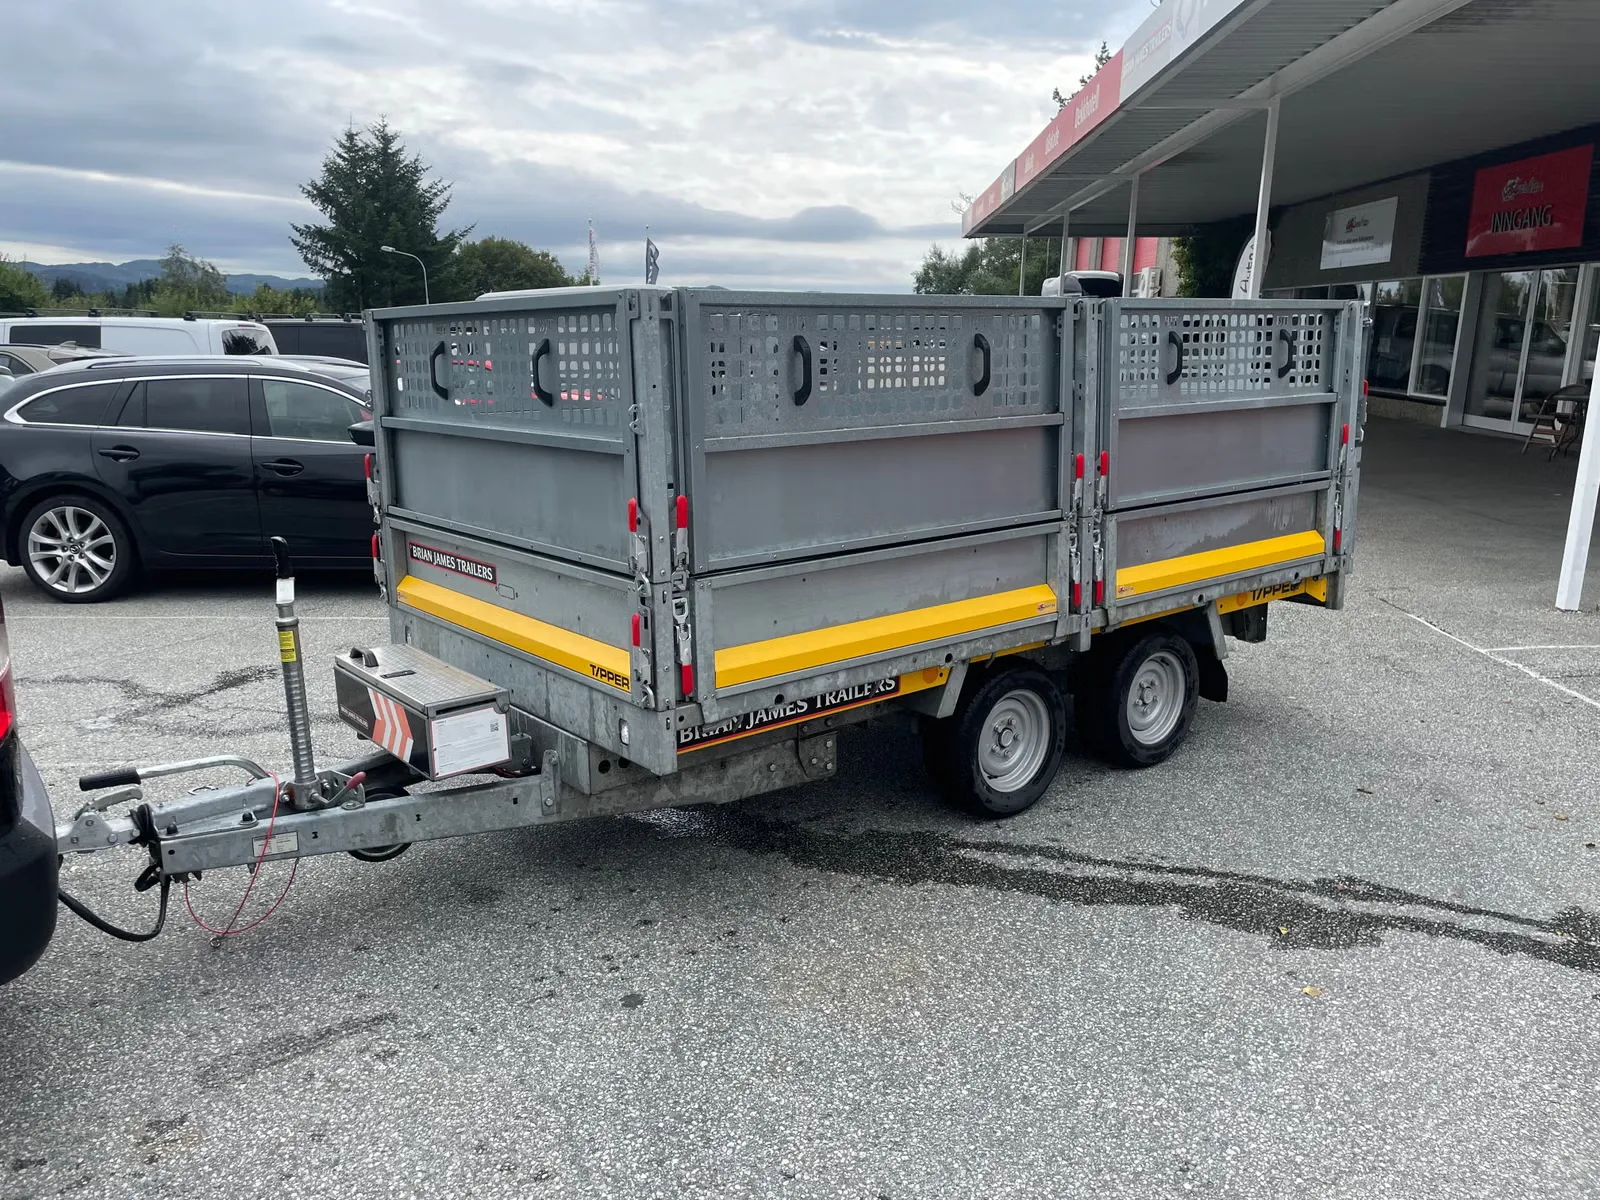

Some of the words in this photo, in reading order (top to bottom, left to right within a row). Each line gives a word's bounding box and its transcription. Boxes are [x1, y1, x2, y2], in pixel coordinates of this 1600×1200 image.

[1491, 204, 1553, 234] INNGANG
[412, 545, 433, 563] BRIAN
[432, 550, 456, 570] JAMES
[456, 558, 493, 581] TRAILERS
[589, 663, 630, 690] TIPPER
[680, 714, 743, 744] BRAN
[745, 698, 808, 730] JAMES
[815, 677, 896, 709] TRAILERS
